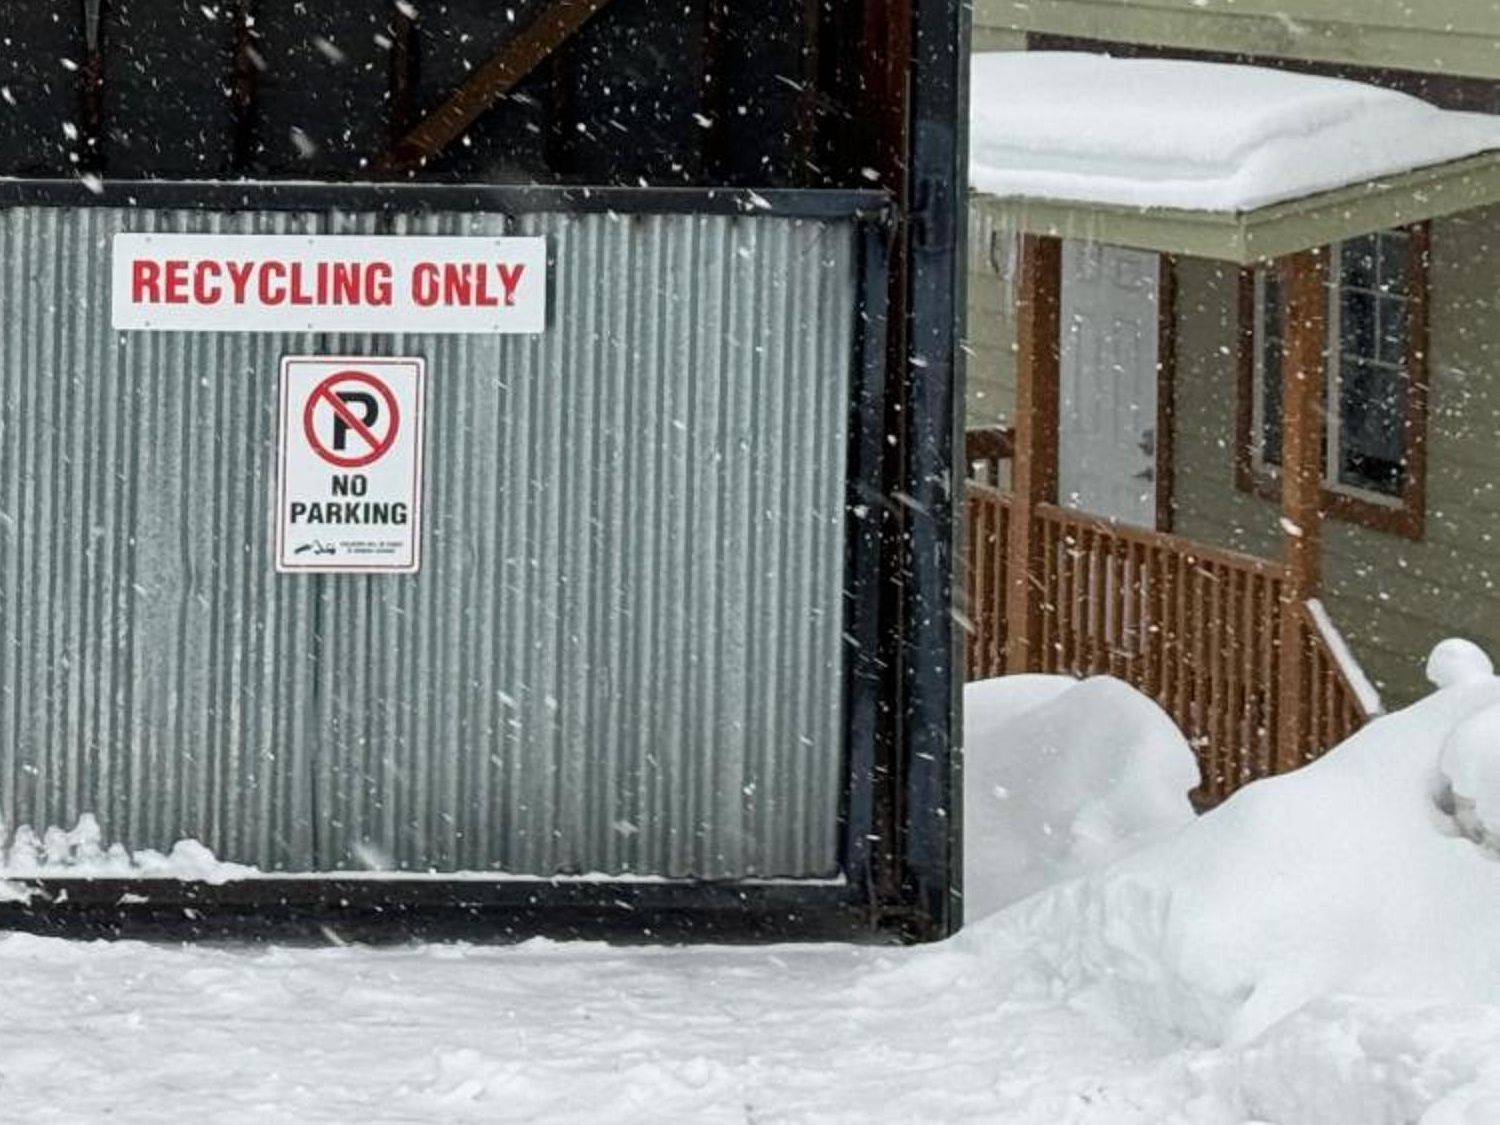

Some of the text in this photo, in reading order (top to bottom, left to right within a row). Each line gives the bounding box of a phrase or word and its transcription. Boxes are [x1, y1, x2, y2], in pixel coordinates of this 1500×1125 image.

[132, 259, 523, 307] RECYCLING ONLY
[332, 475, 366, 496] NO
[291, 503, 406, 524] PARKING
